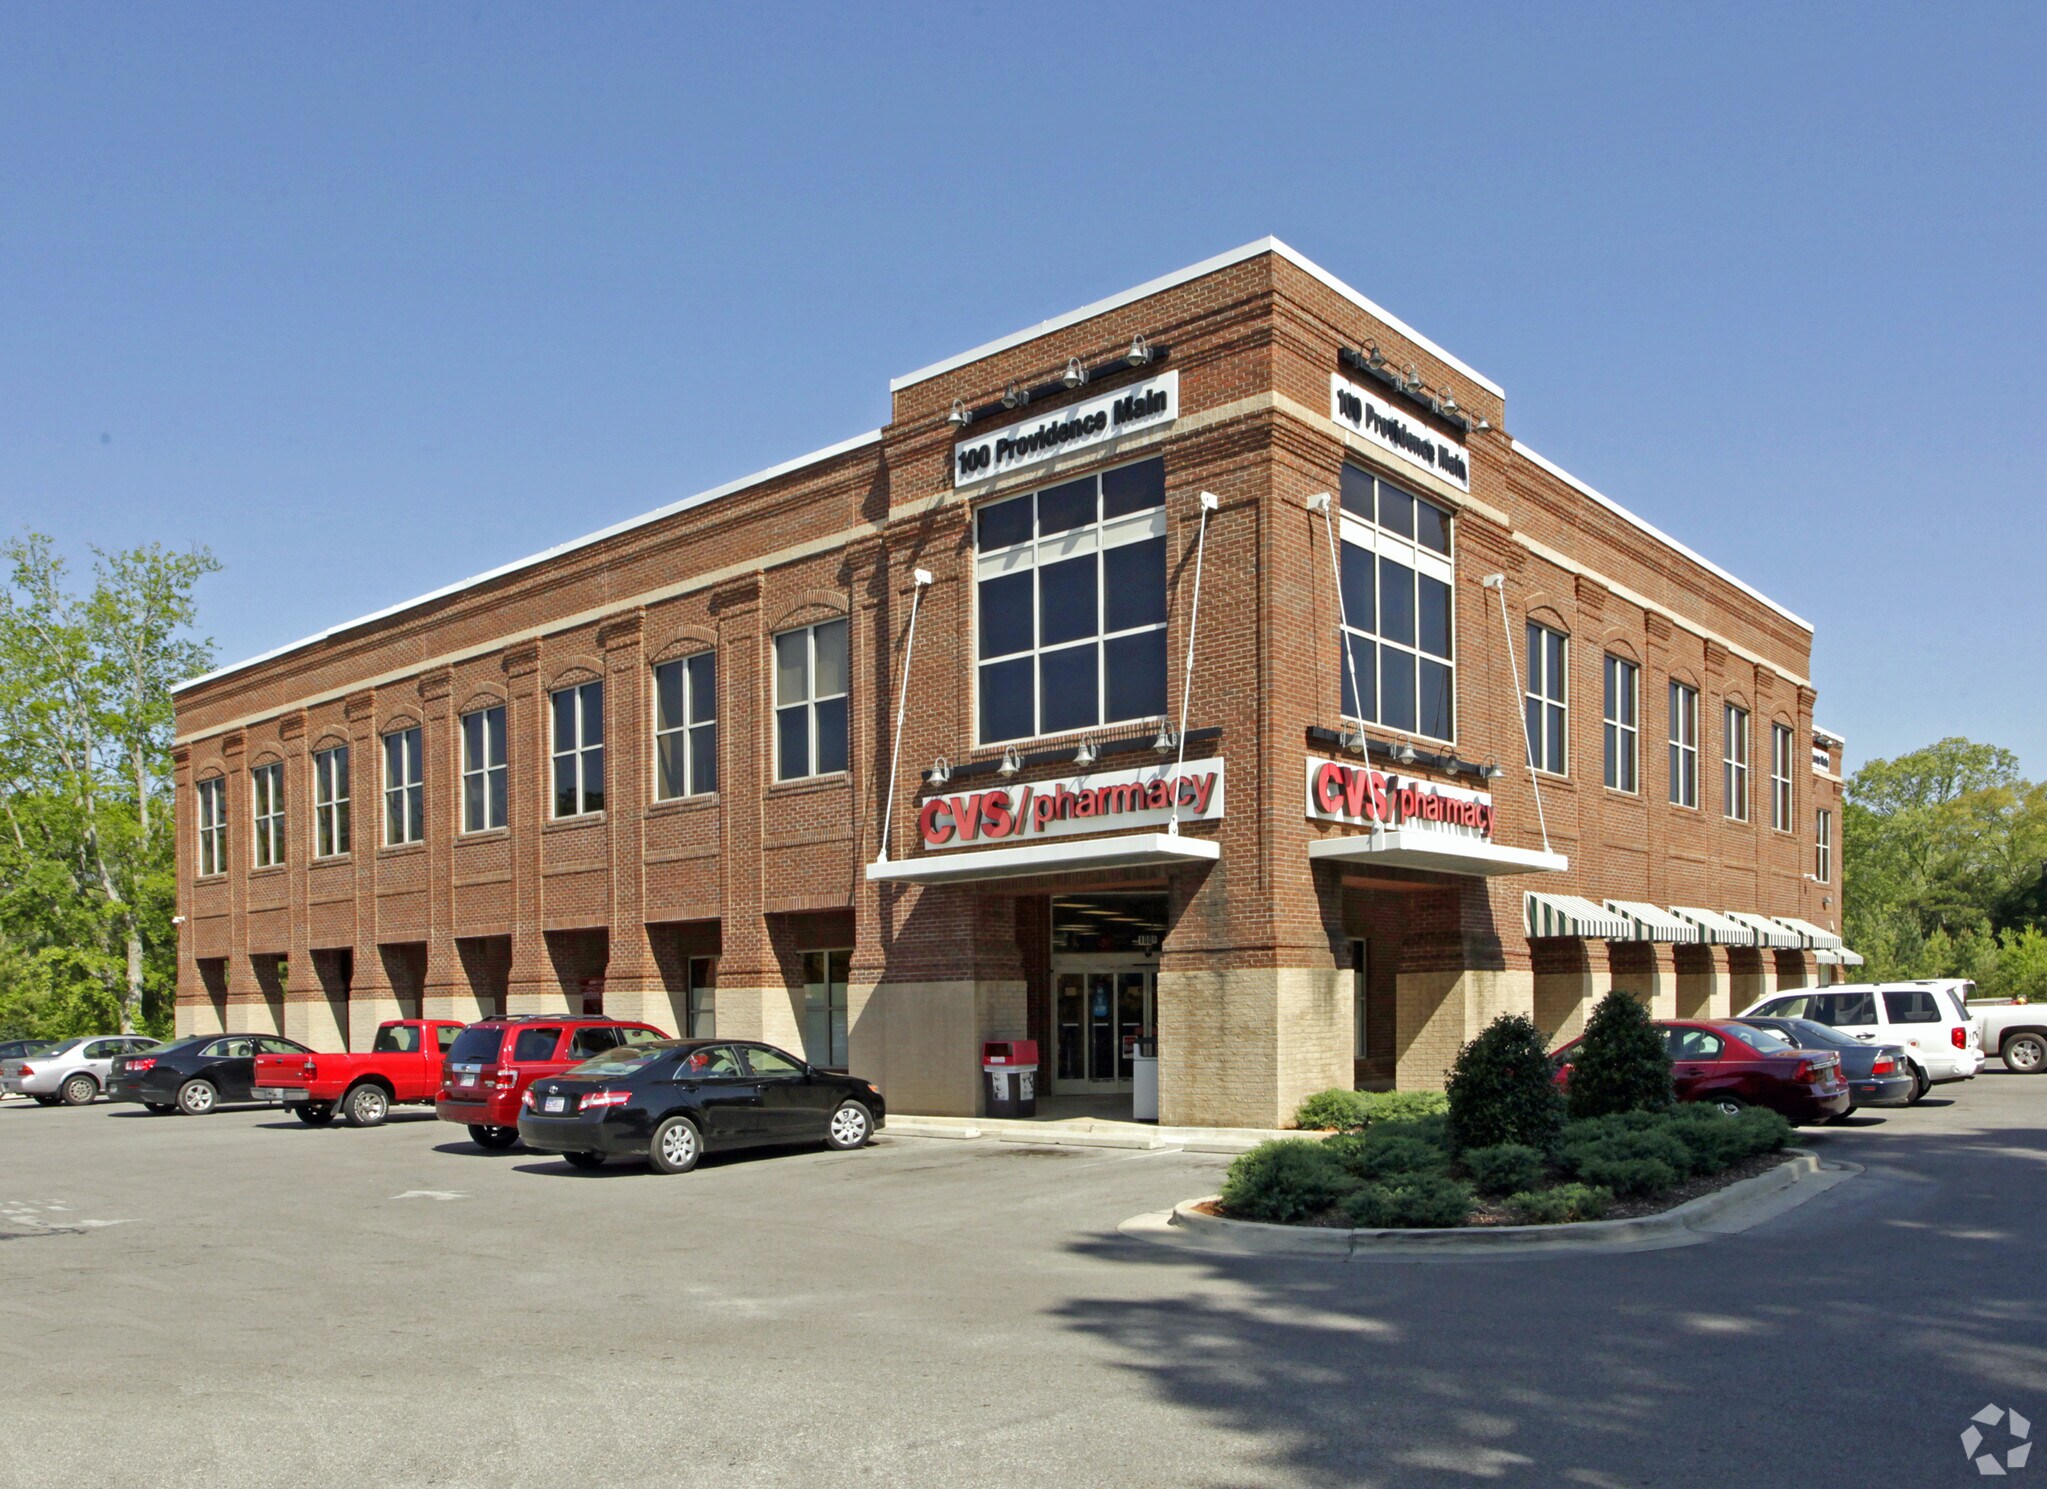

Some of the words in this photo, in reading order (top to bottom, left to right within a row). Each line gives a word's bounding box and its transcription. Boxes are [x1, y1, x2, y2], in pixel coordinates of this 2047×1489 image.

[958, 444, 991, 474] 100
[996, 410, 1107, 463] Providence
[1113, 388, 1167, 425] Main
[1365, 402, 1435, 464] Providence
